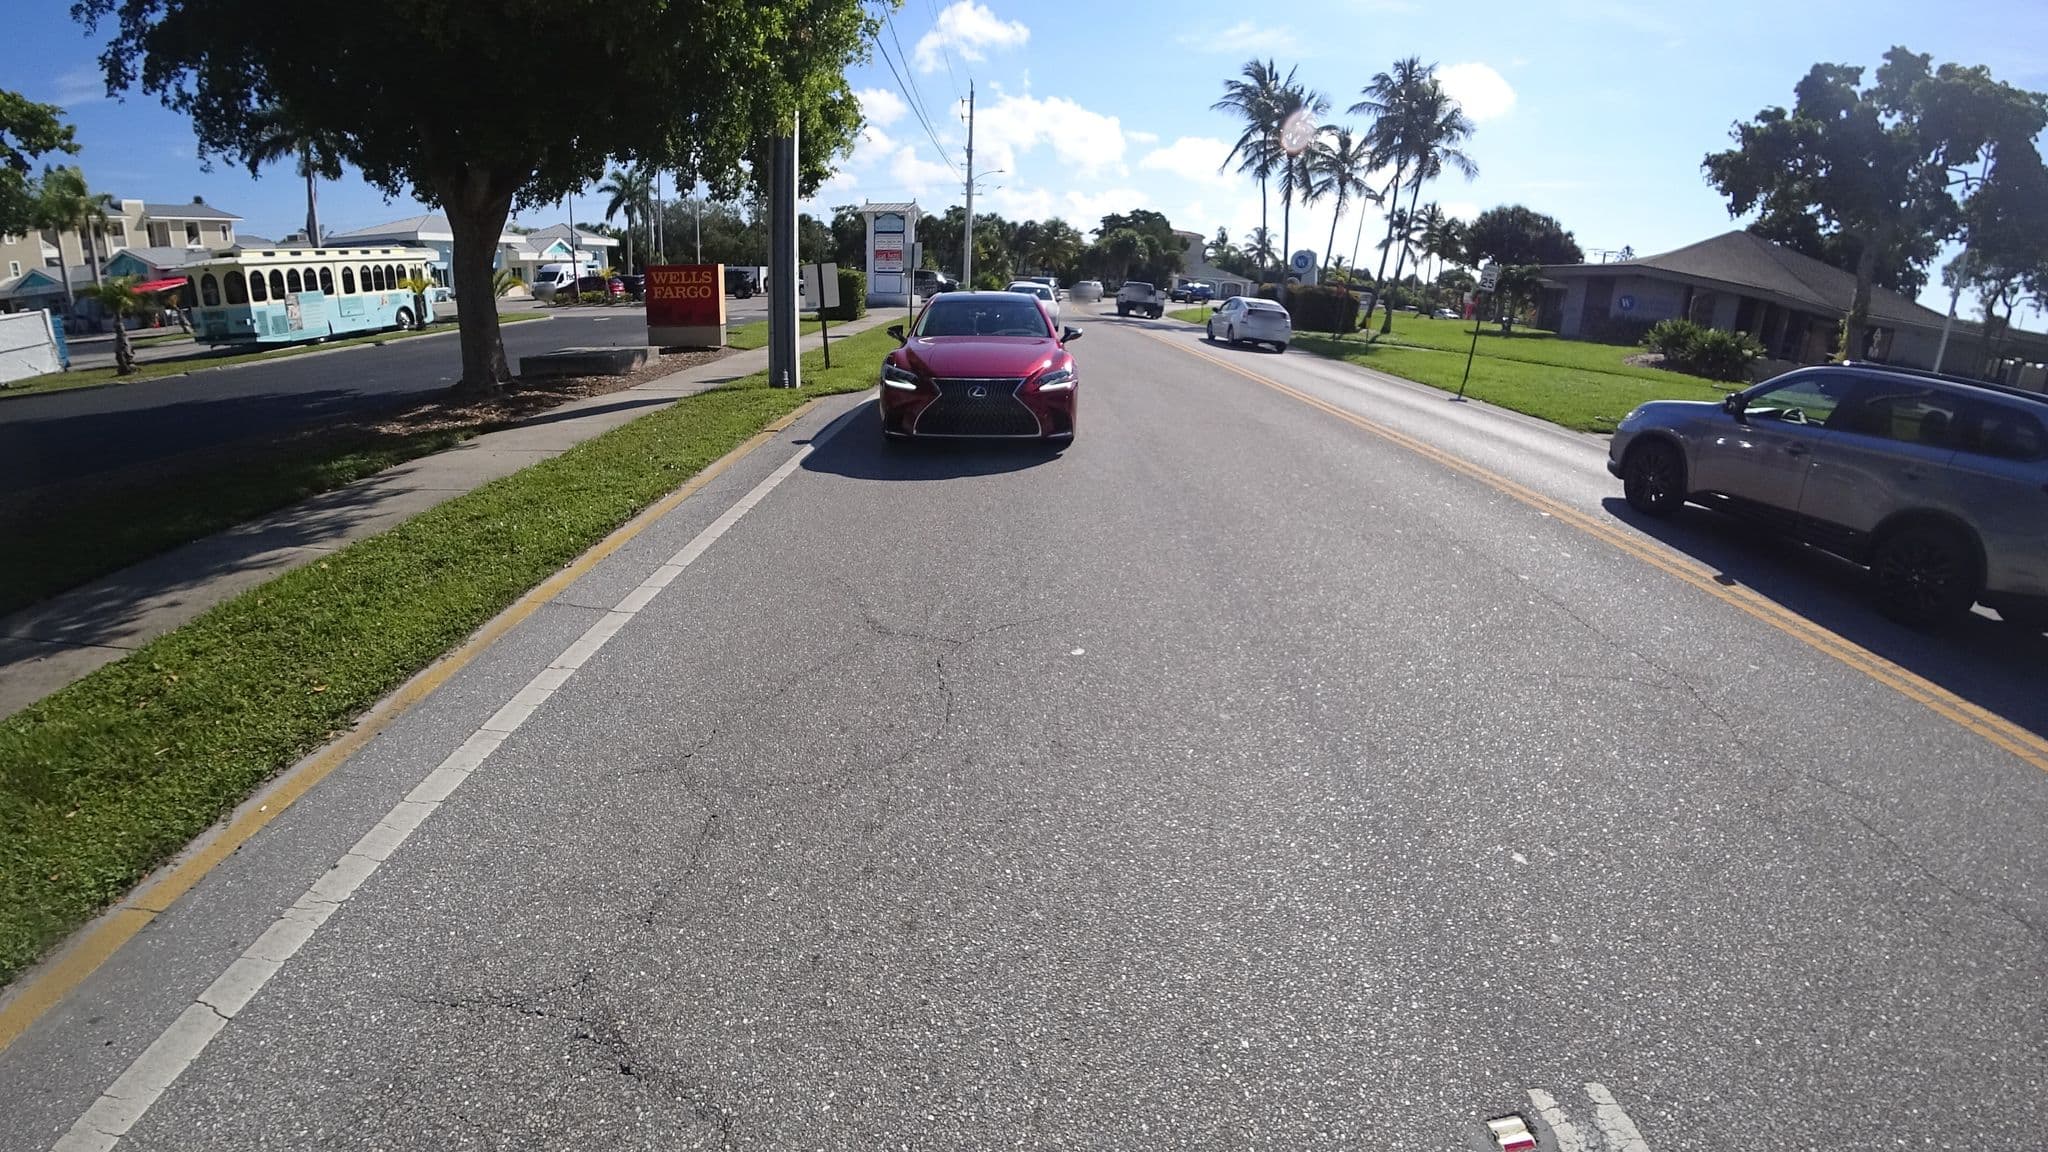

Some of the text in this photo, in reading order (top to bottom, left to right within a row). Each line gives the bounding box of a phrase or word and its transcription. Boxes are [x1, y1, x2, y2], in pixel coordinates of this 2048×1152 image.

[651, 271, 713, 284] WELLS
[1480, 277, 1495, 289] 25
[653, 286, 712, 299] FARGO
